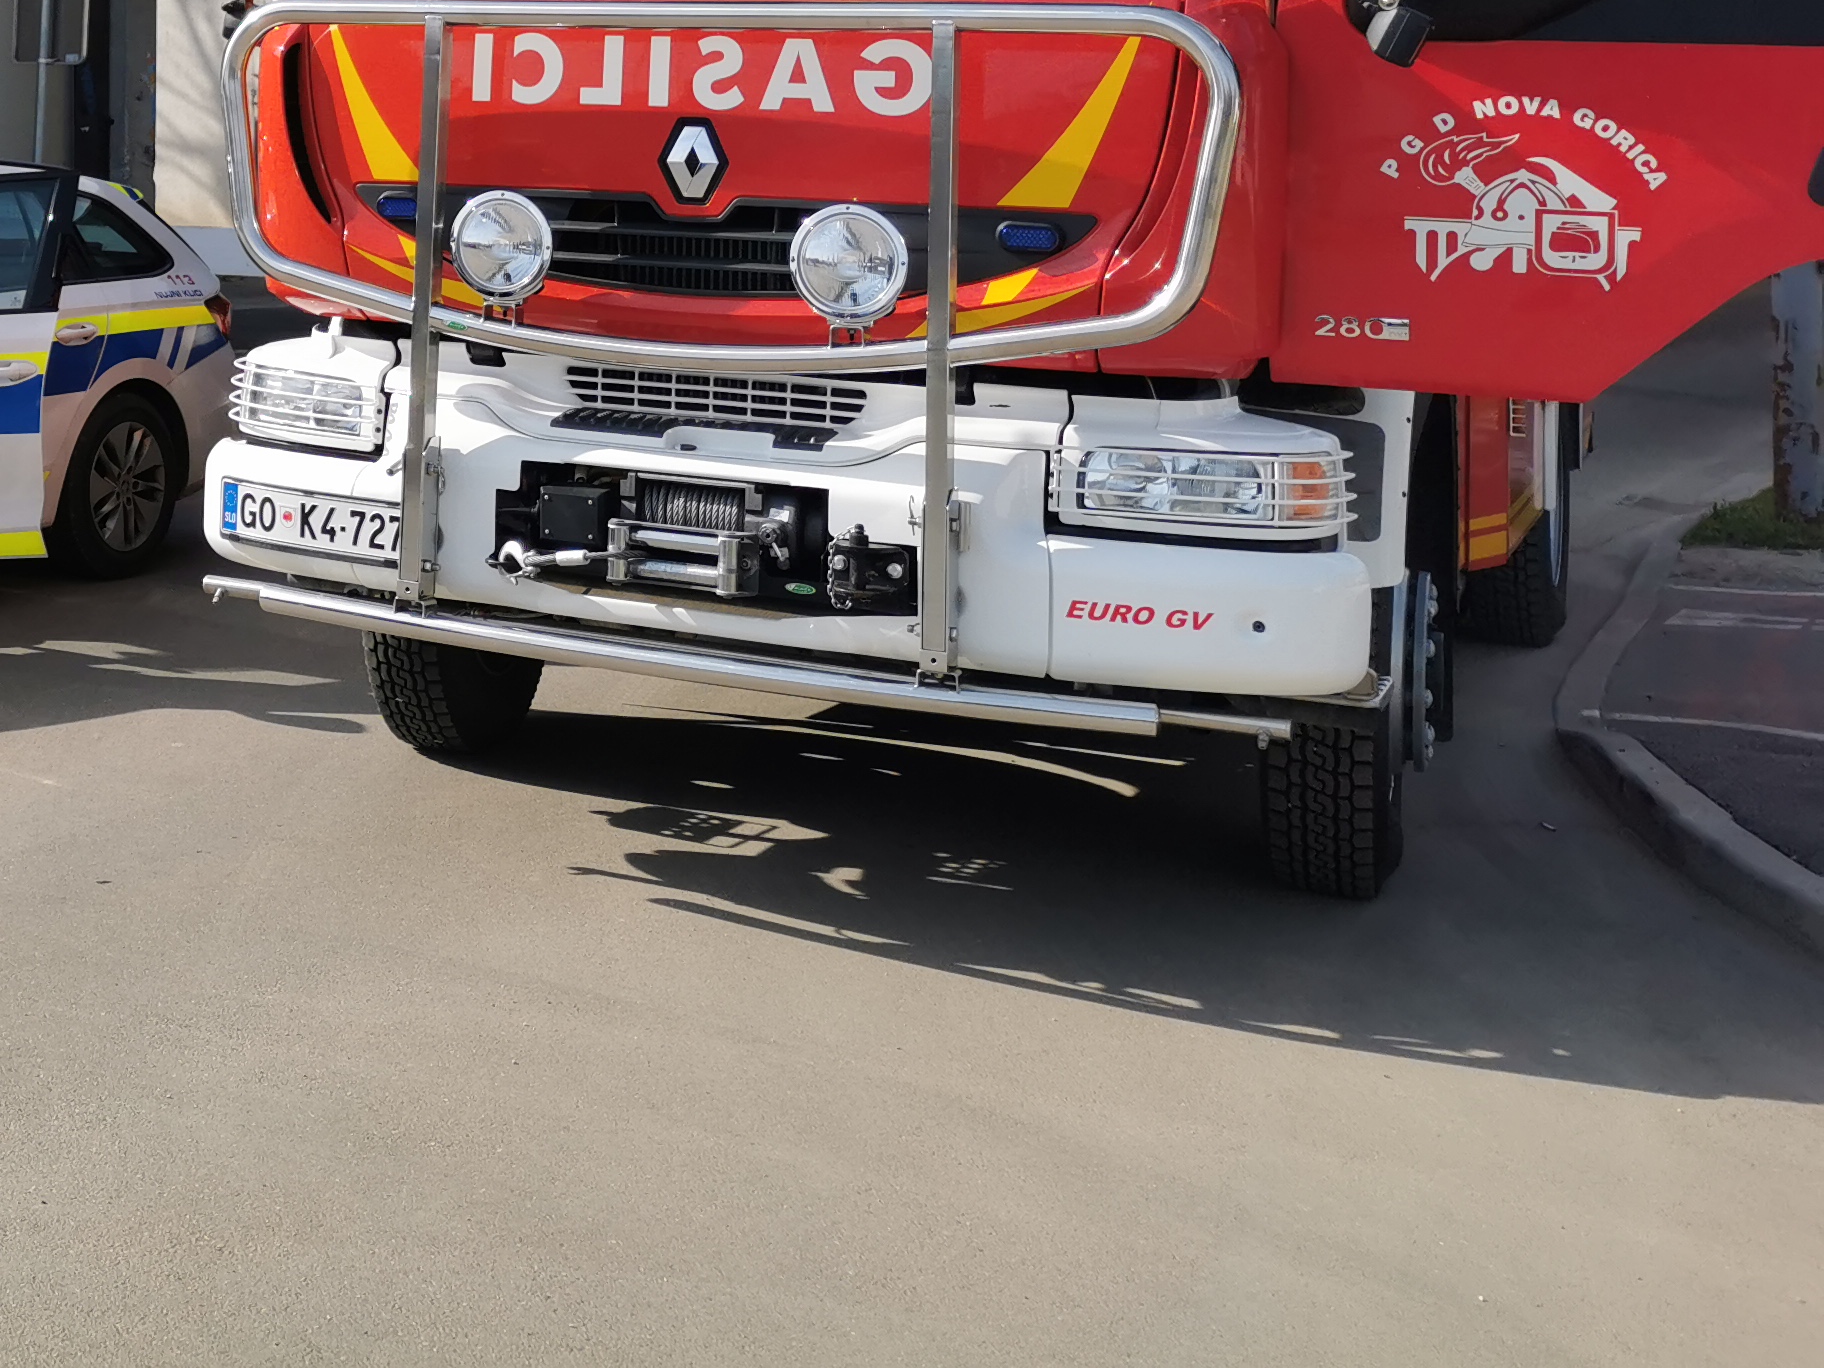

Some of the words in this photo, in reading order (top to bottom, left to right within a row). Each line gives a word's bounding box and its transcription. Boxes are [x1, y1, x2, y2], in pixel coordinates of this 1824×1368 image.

[1472, 95, 1561, 119] NOVA
[1572, 107, 1668, 191] GORICA
[167, 274, 196, 286] 113
[1314, 314, 1387, 341] 280
[224, 511, 236, 524] SLO
[240, 492, 276, 533] GO
[299, 501, 401, 553] K4-727
[1065, 599, 1156, 626] EURO
[1165, 609, 1215, 631] GV
